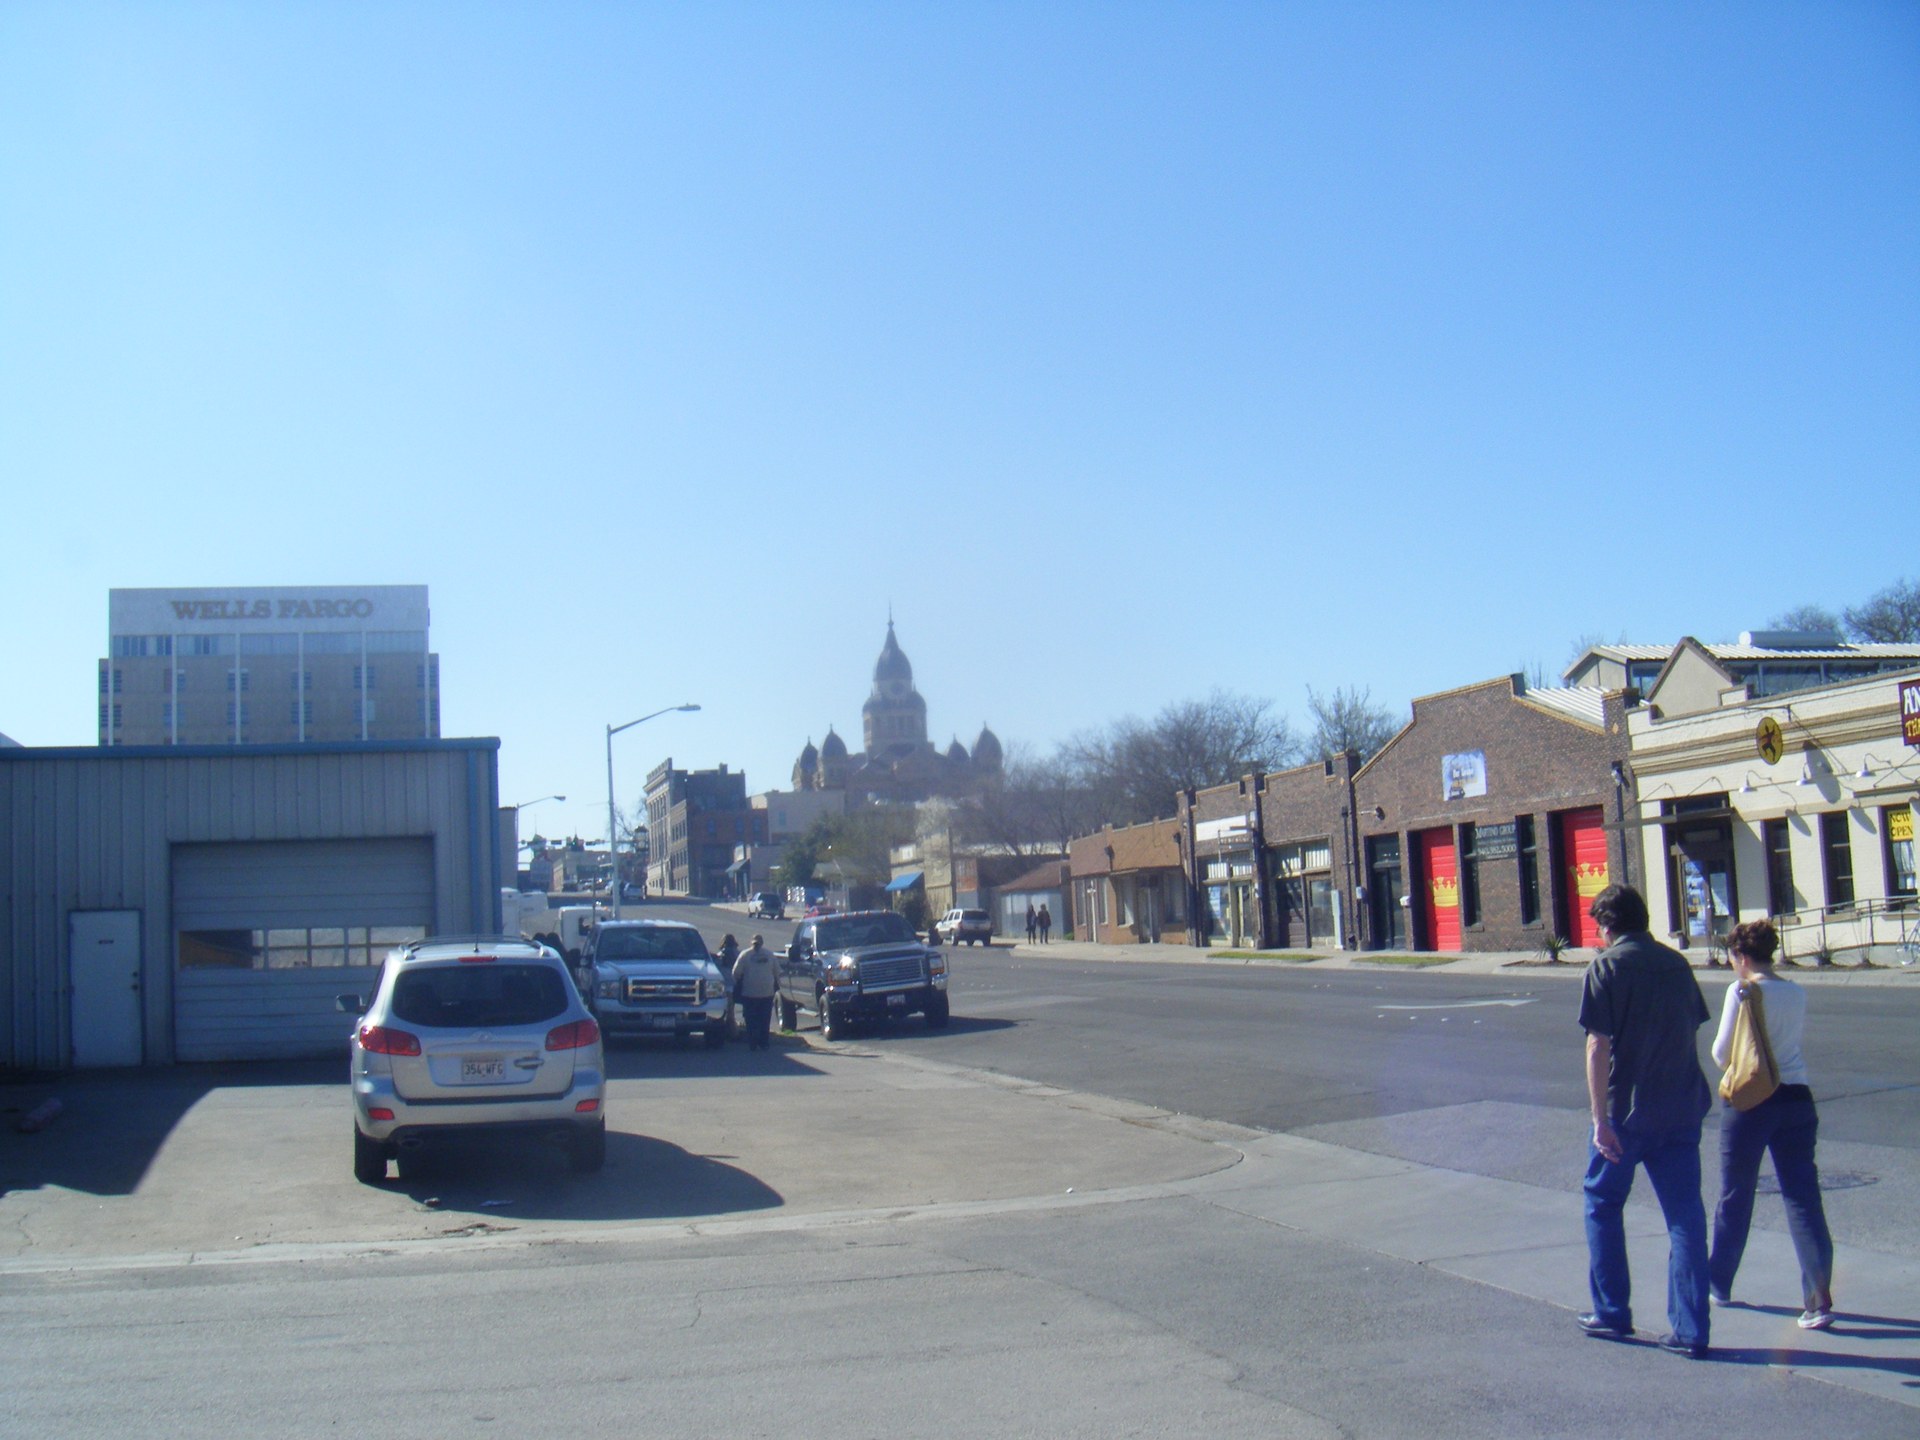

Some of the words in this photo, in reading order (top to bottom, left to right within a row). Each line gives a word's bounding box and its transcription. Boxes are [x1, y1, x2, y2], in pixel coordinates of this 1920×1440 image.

[171, 600, 272, 620] WELLS
[276, 598, 374, 619] FARGO
[1890, 812, 1911, 823] NOW
[1890, 825, 1913, 837] OPEN
